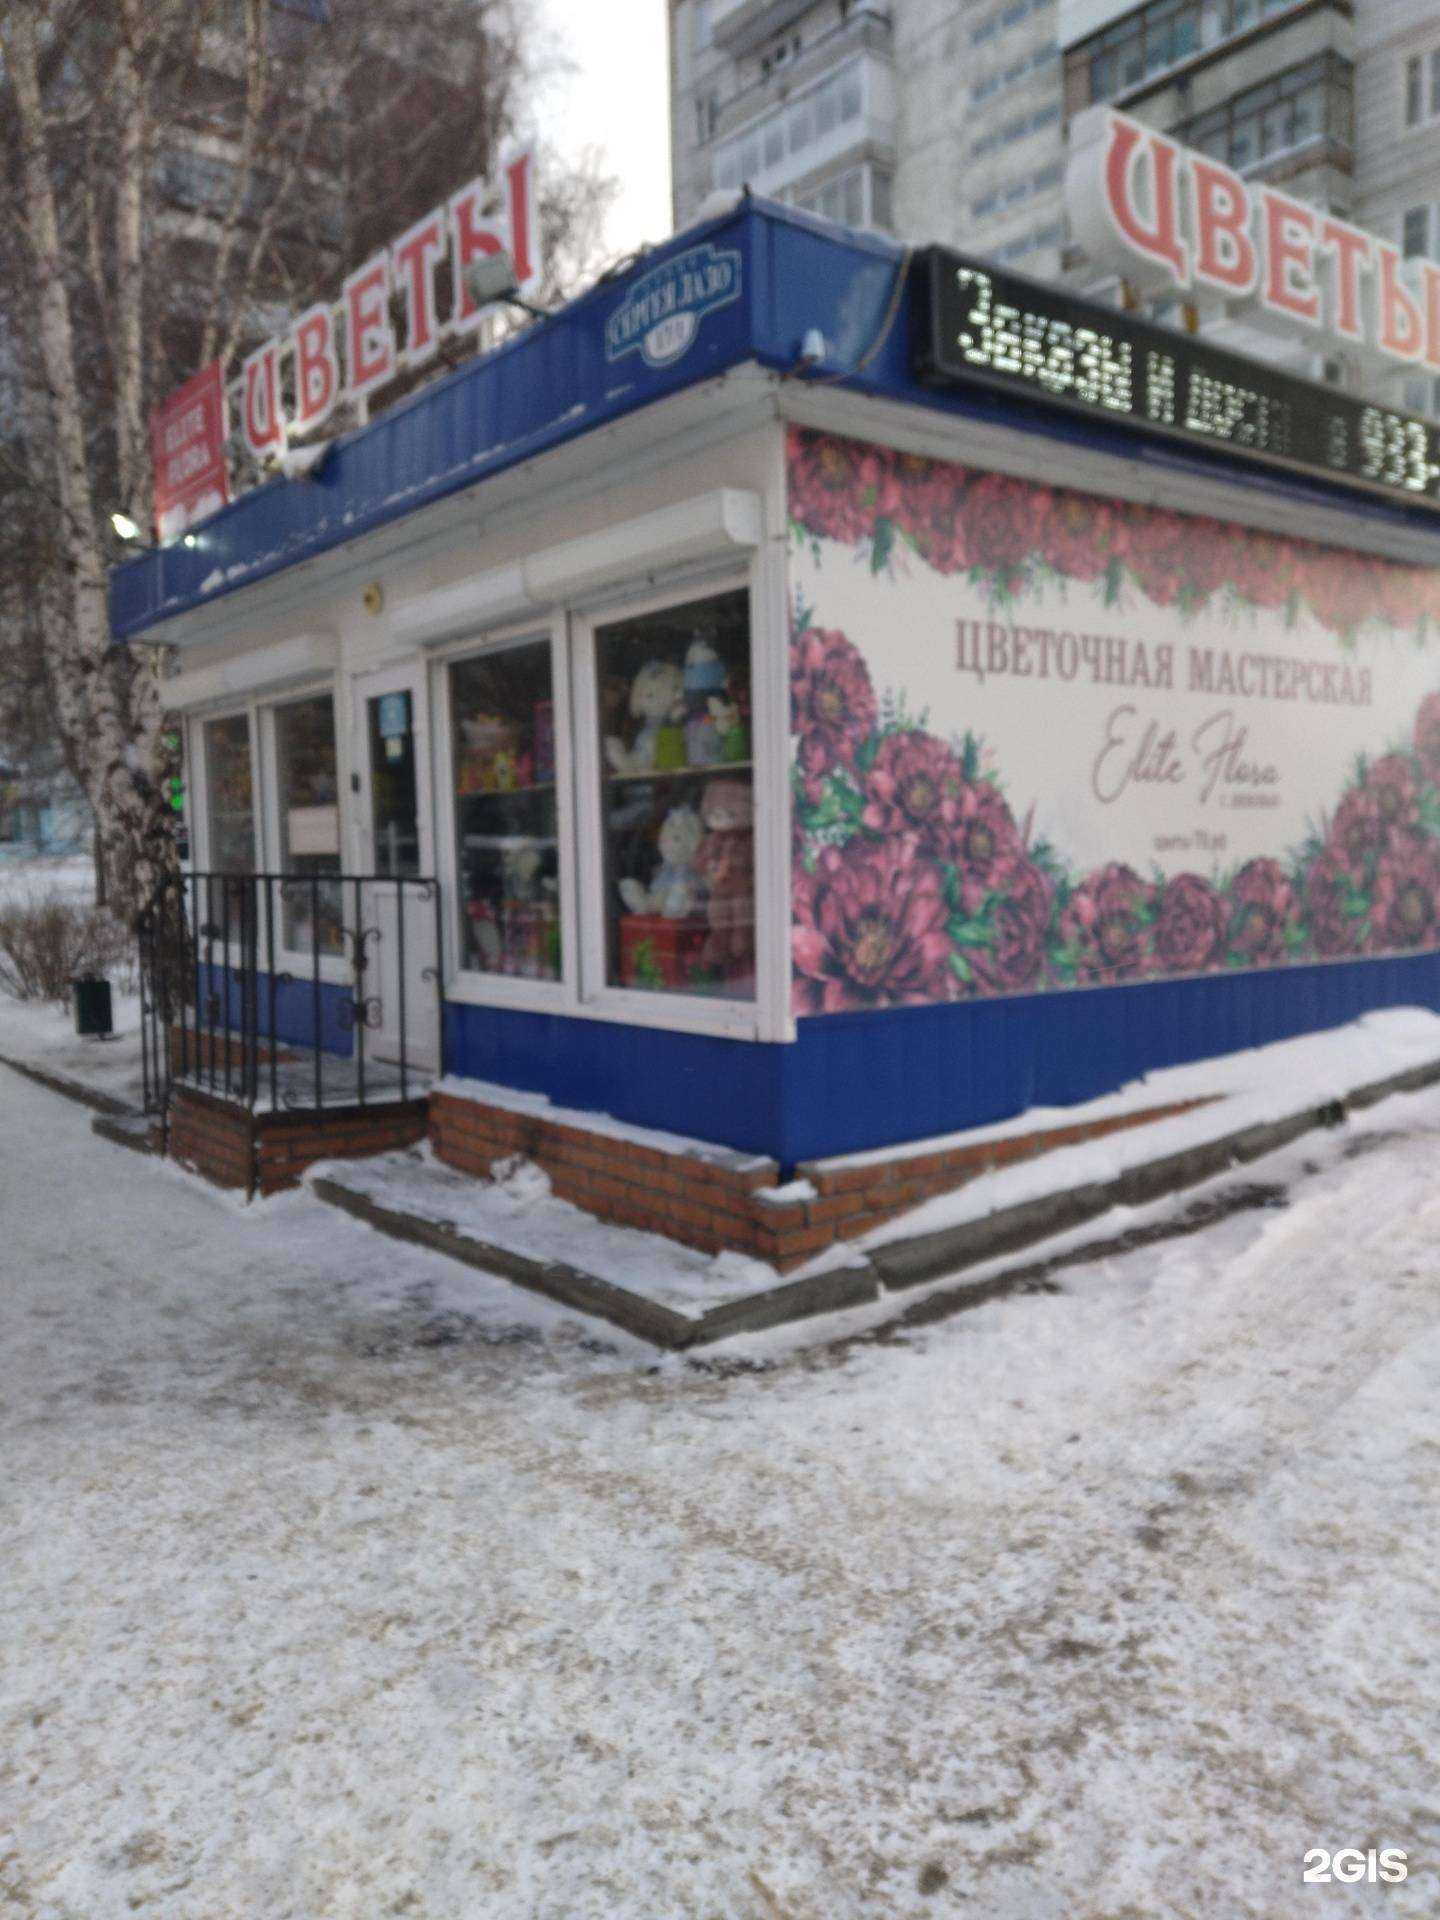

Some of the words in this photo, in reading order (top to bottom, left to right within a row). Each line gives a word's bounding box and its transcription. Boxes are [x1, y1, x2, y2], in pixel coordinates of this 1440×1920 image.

[244, 152, 535, 451] ЦВЕТЫ
[1106, 115, 1440, 368] ЦВЕТЫ
[954, 617, 1175, 690] ЦВЕТОЧНАЯ
[1188, 645, 1372, 706] МАСТЕРСКАЯ
[1092, 704, 1187, 804] Elite
[1191, 709, 1282, 805] Flora
